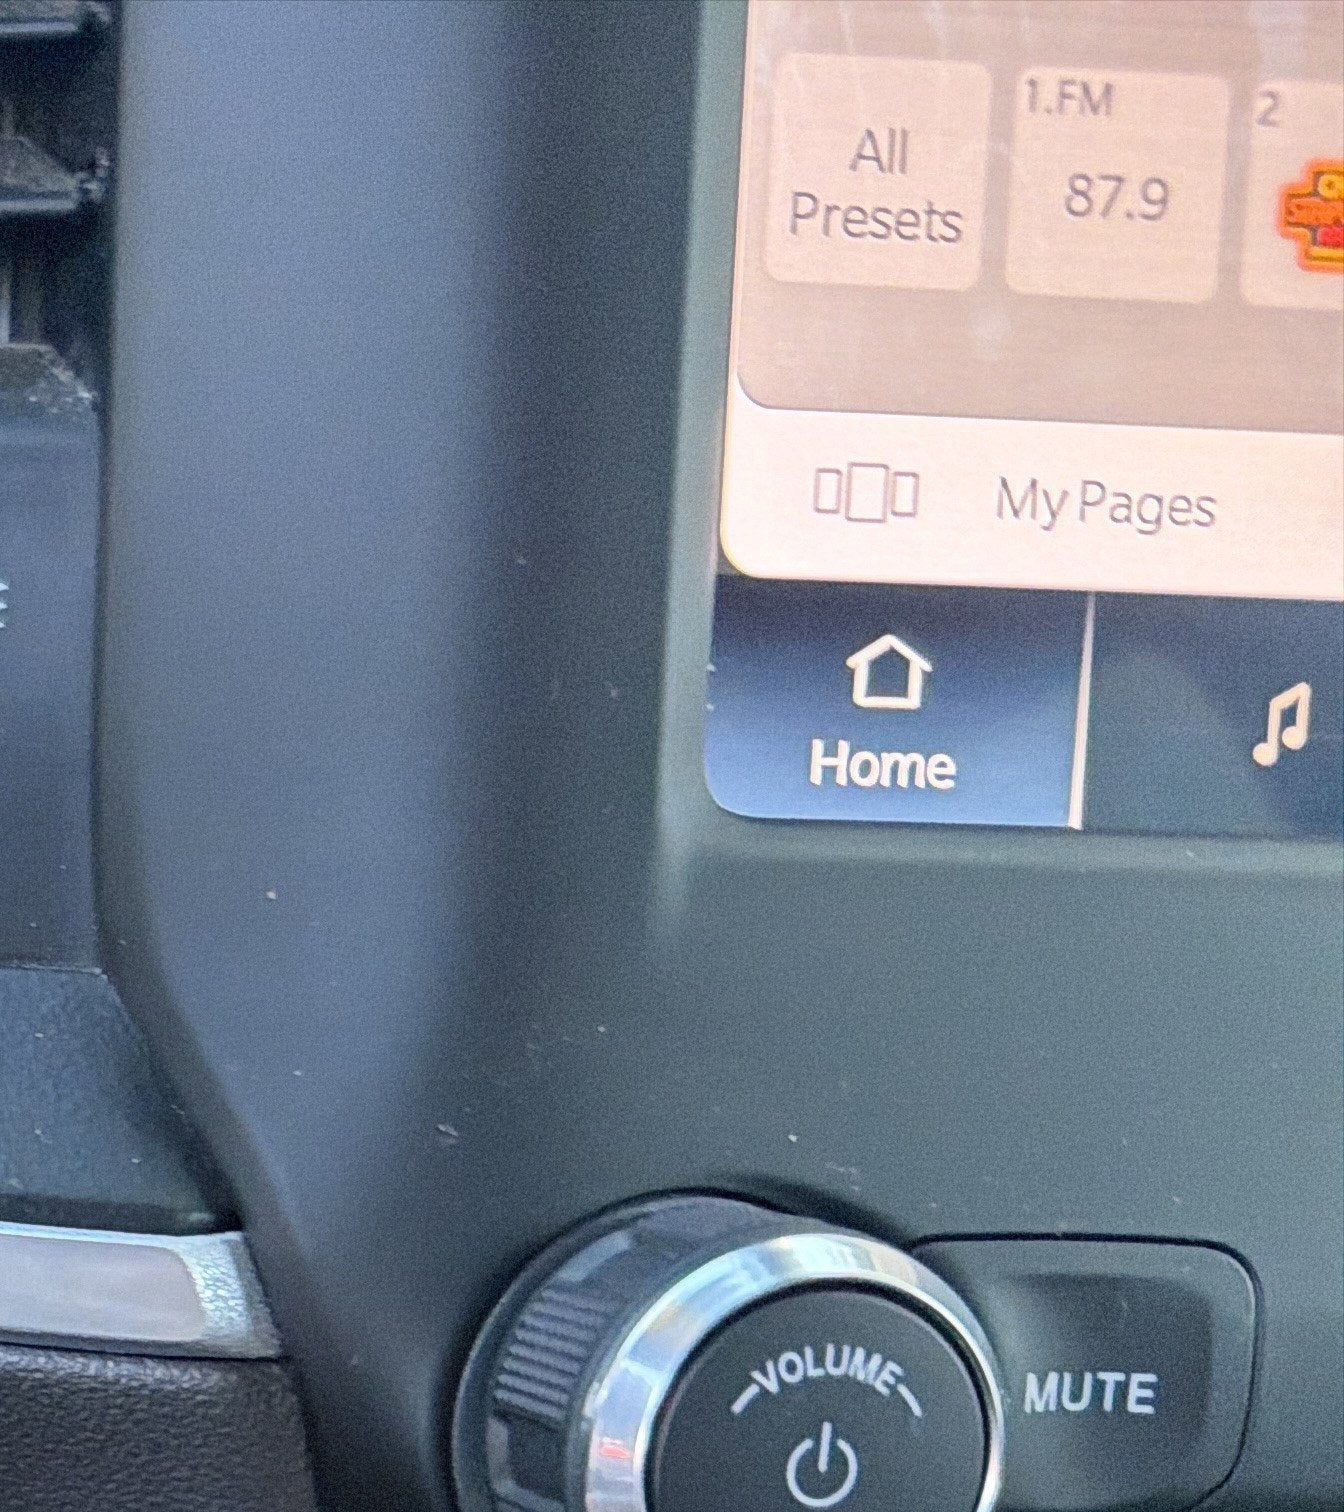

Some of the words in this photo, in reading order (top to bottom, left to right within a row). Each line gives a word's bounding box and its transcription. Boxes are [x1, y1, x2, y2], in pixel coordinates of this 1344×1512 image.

[1024, 78, 1113, 116] 1.FM
[1257, 90, 1281, 128] 2
[849, 127, 910, 175] All
[788, 191, 963, 245] Presets
[1064, 173, 1171, 222] 87.9
[994, 475, 1070, 532] My
[1078, 479, 1218, 535] Pages
[809, 738, 958, 790] Home
[750, 1343, 900, 1397] VOLUME
[1023, 1371, 1158, 1415] MUTE
